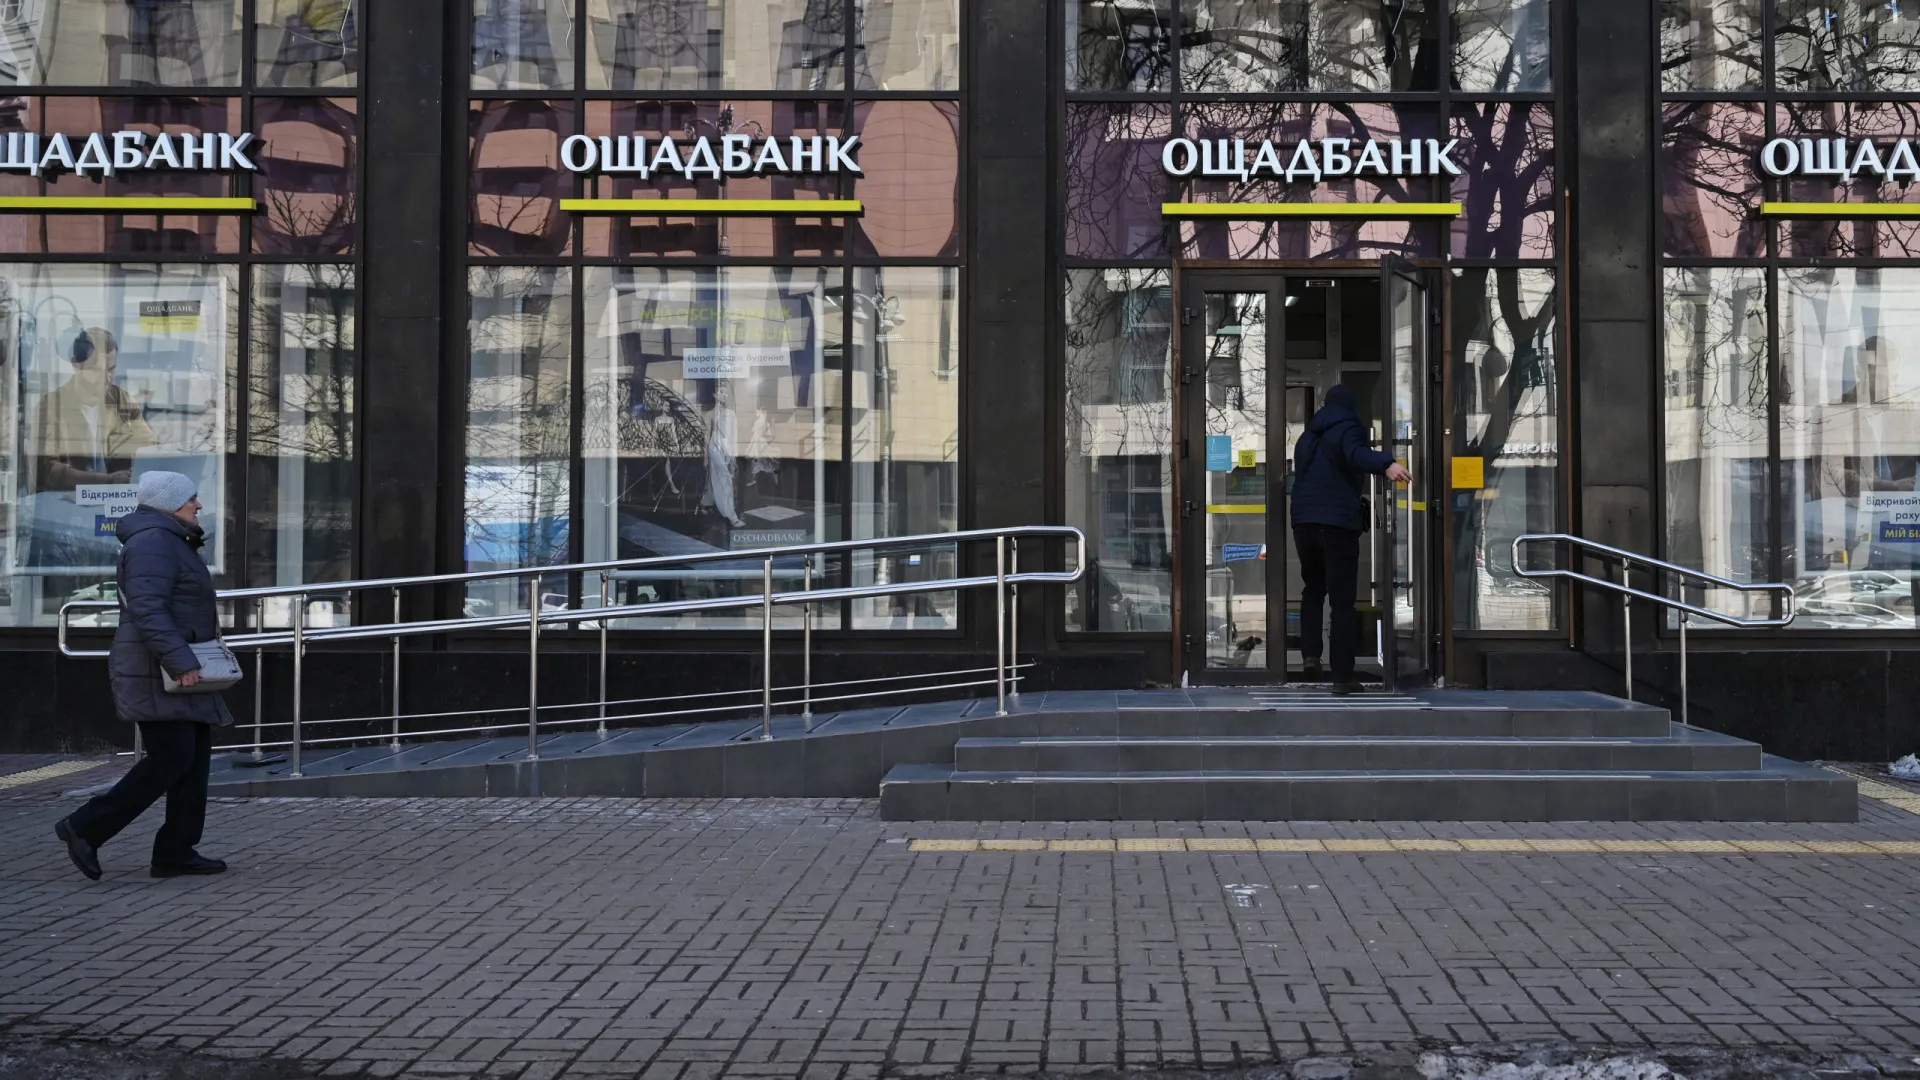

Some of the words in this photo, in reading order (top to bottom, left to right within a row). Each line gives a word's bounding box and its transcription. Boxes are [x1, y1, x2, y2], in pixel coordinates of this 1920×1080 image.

[560, 133, 861, 181] ОЩАДБАНК
[1162, 137, 1462, 183] ОЩАДБАНК
[146, 305, 194, 313] ОЩАДБАНК
[733, 533, 803, 542] OSCHADBANK
[1884, 527, 1906, 538] МІЙ
[1908, 529, 1920, 538] БІ
